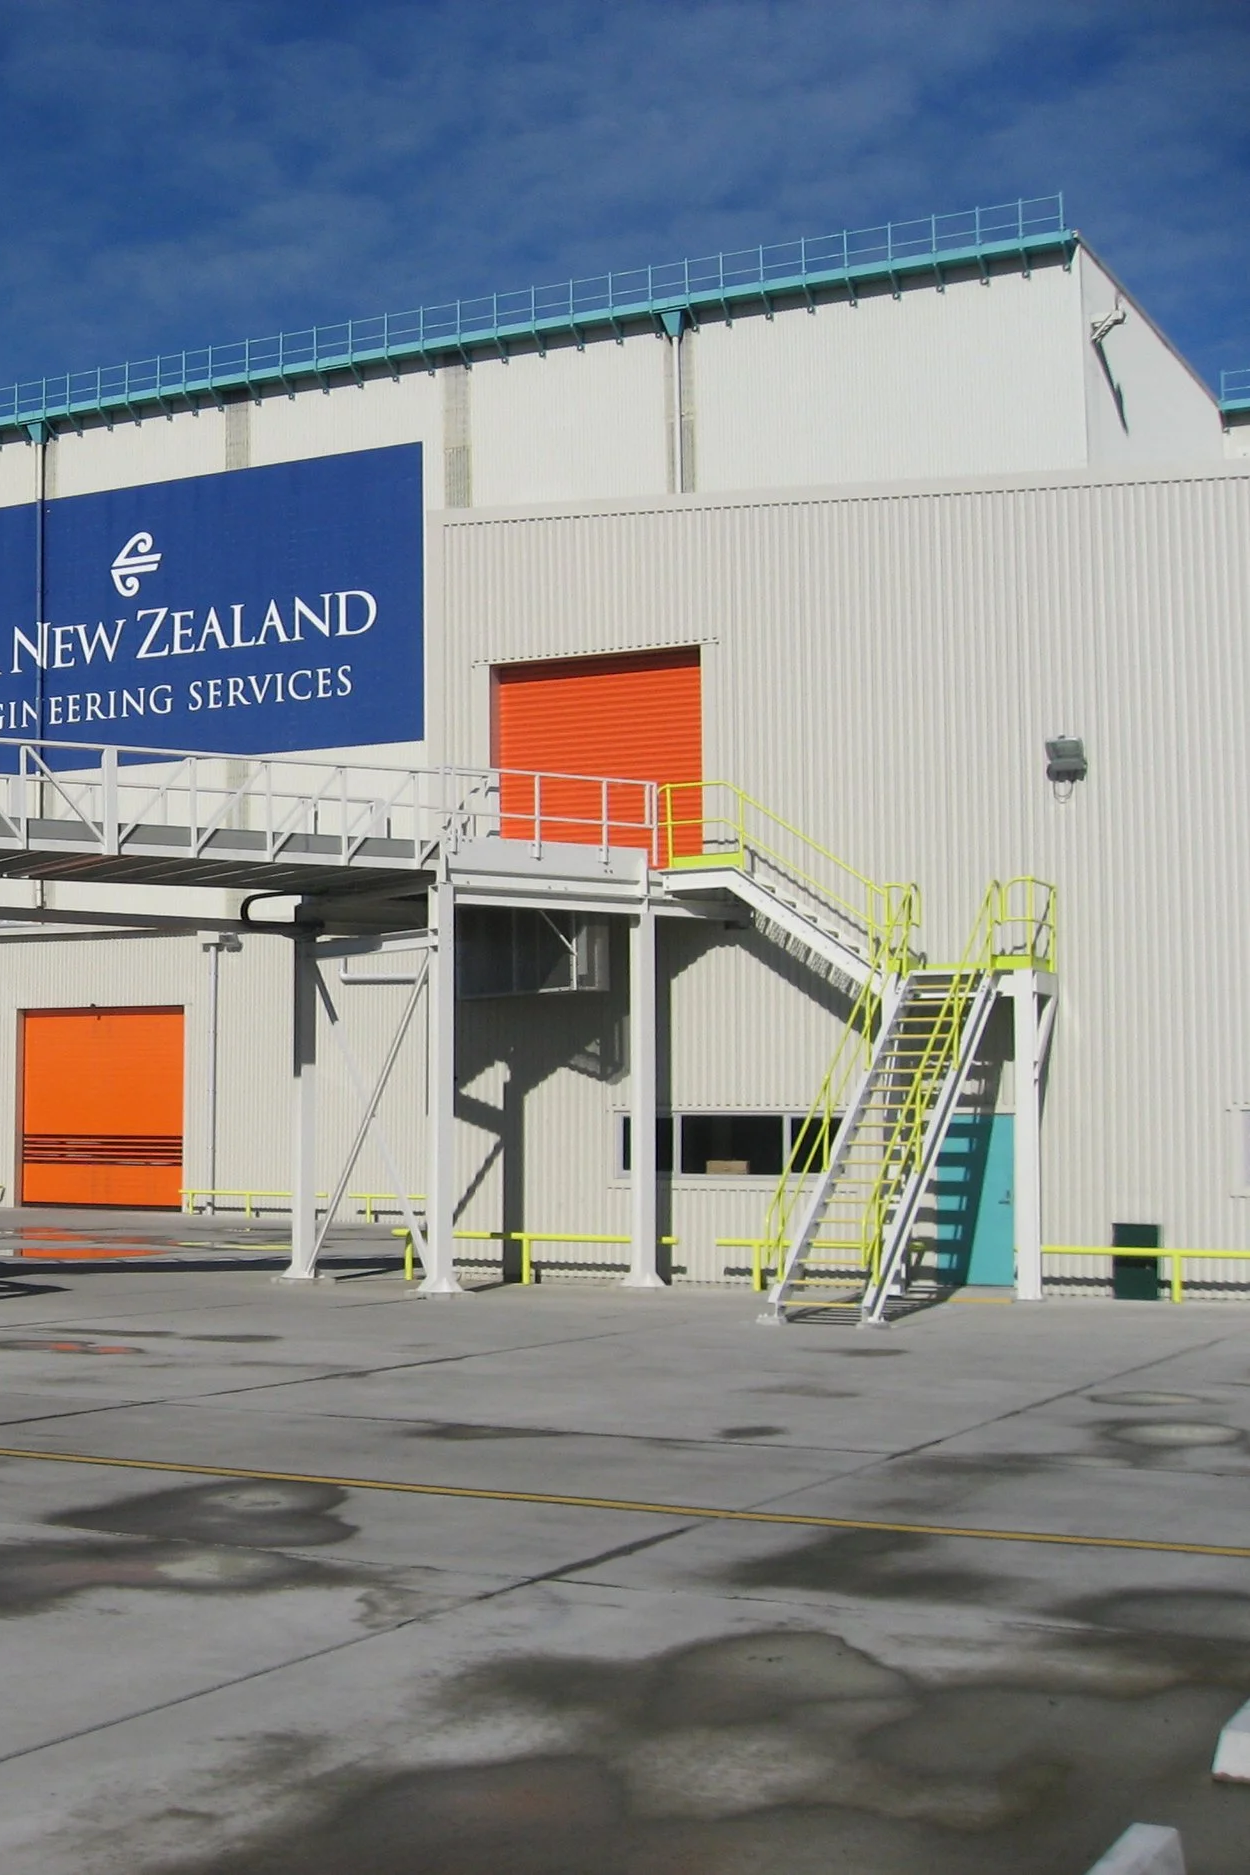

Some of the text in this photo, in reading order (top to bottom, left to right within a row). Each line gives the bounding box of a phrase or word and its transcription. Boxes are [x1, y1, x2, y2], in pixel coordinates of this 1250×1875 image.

[10, 619, 127, 674] NEW
[136, 590, 377, 660] ZEALAND
[188, 665, 352, 712] SERVICES
